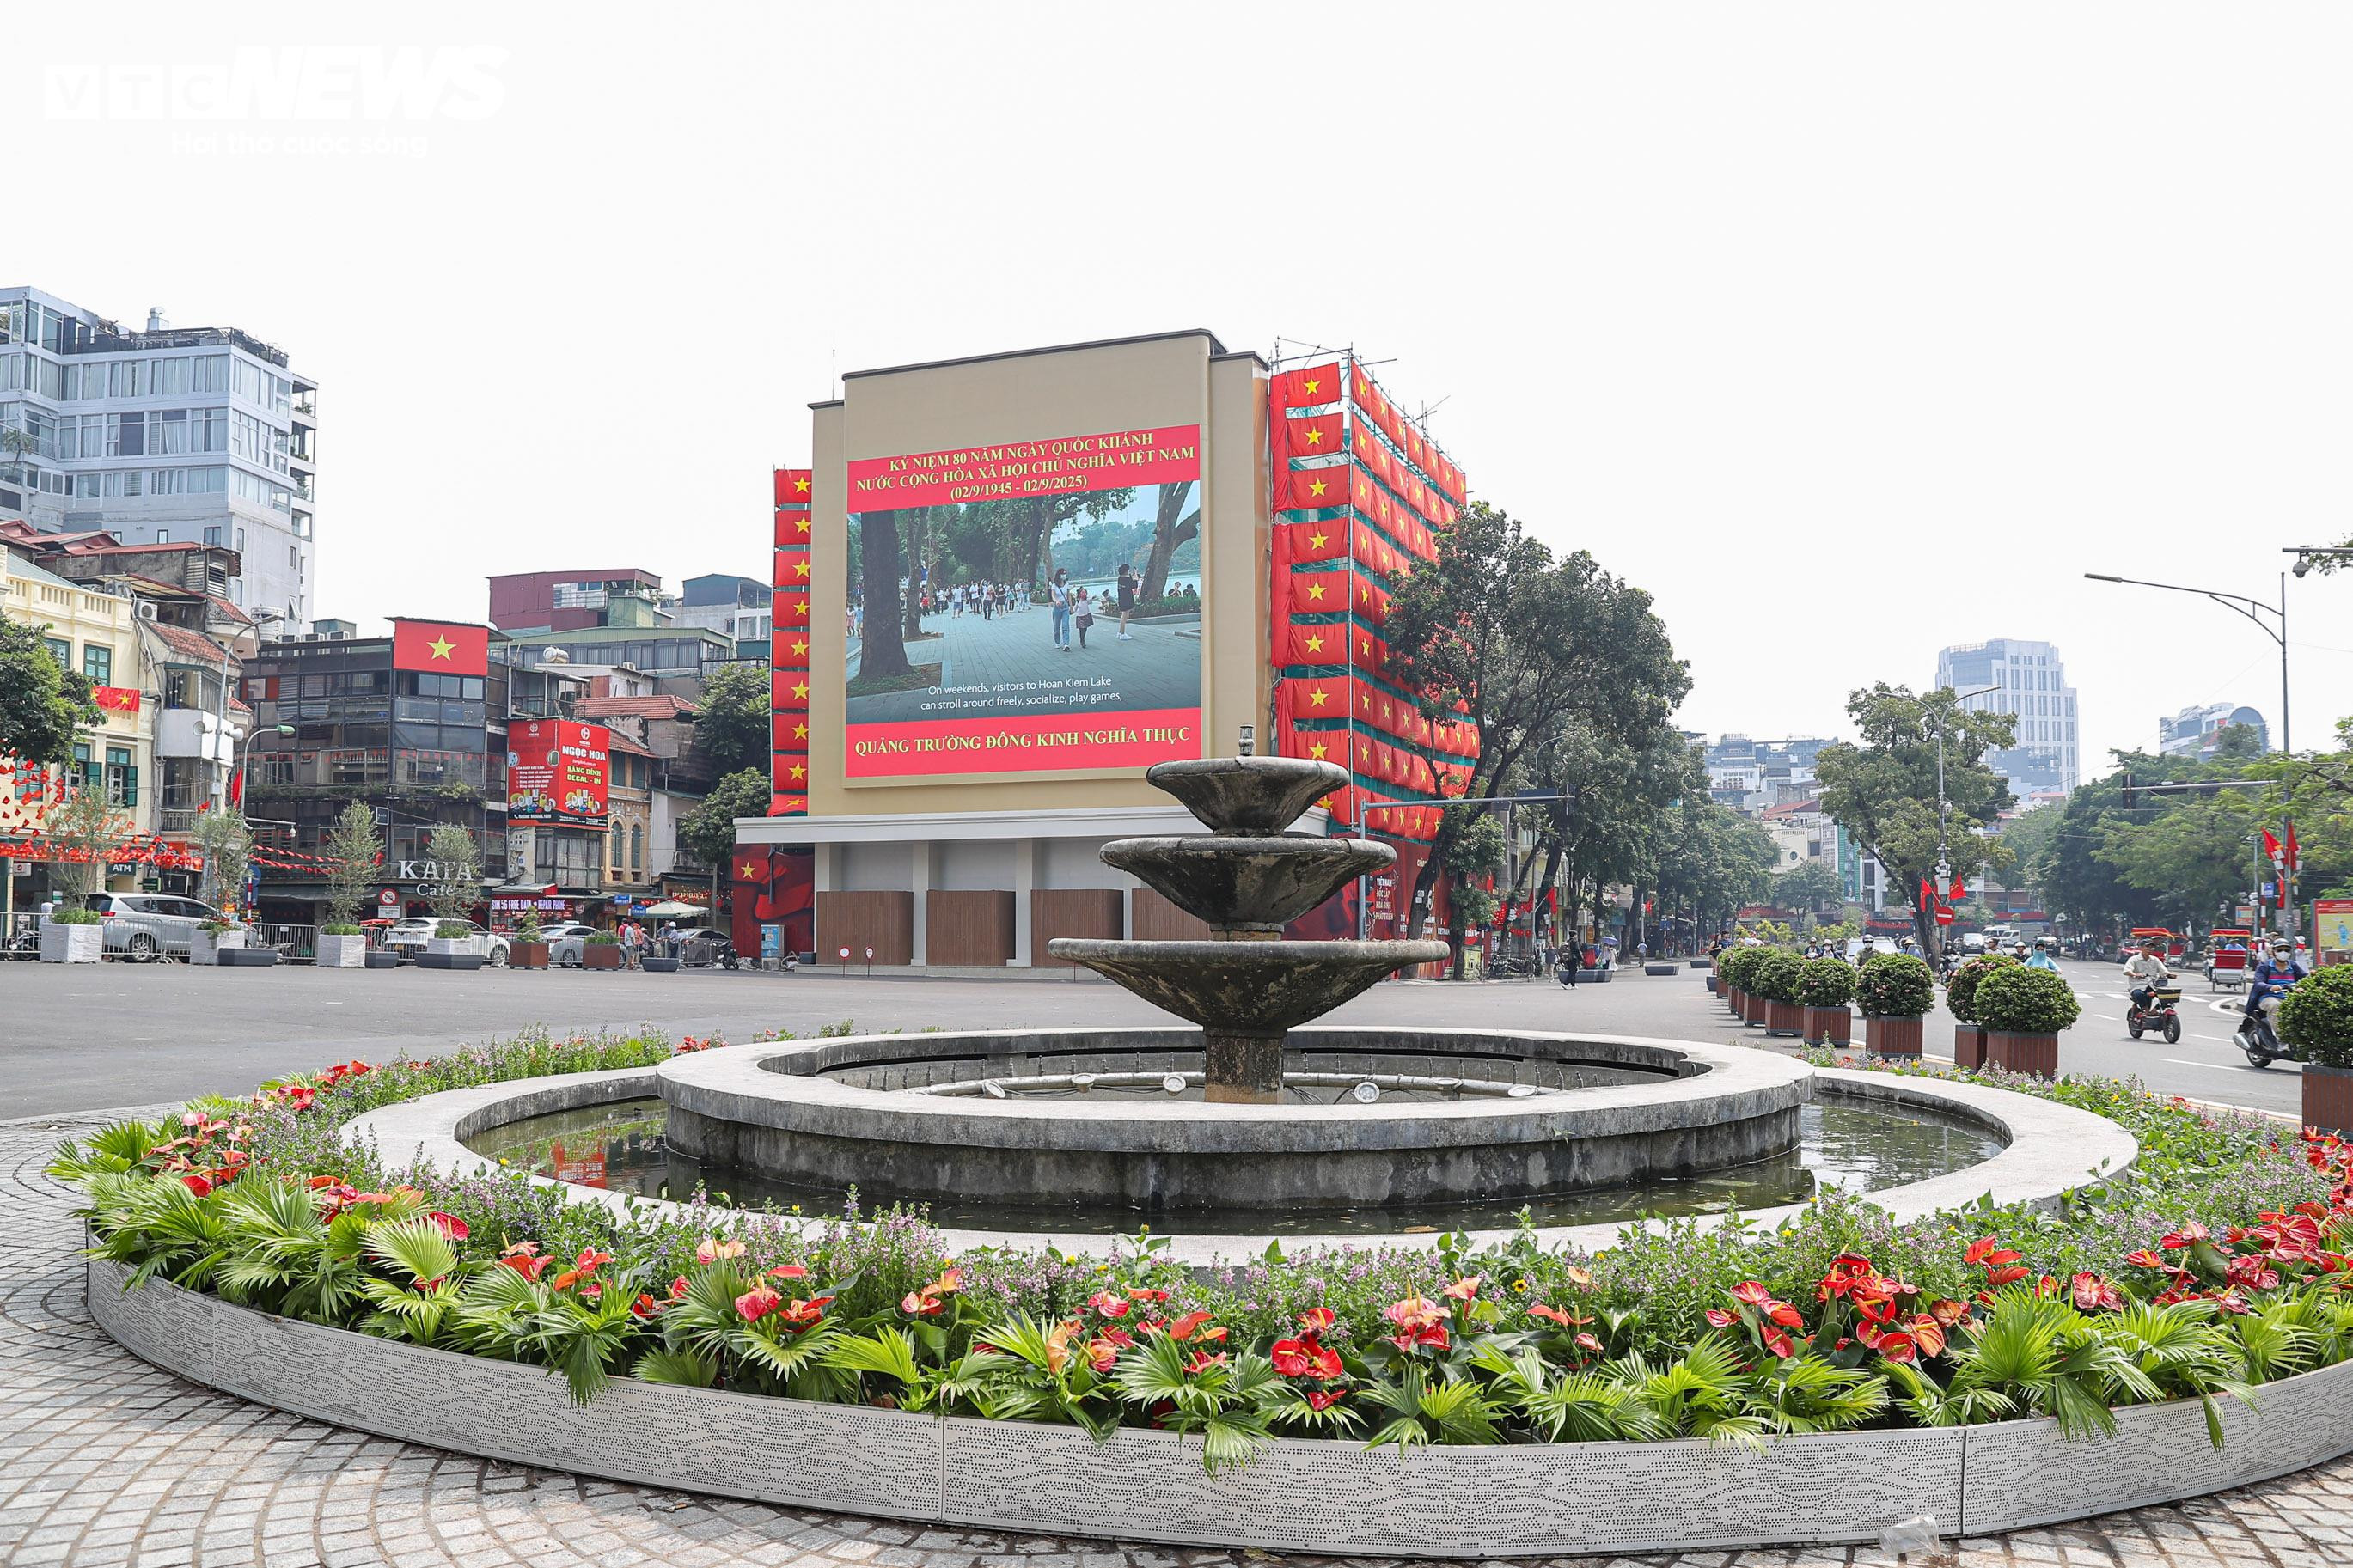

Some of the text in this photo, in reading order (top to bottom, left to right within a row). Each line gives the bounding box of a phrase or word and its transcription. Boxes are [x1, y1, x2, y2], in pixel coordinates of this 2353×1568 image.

[913, 455, 949, 470] NIỆM
[953, 453, 967, 465] 80
[970, 447, 1003, 463] NĂM
[1006, 442, 1048, 459] NGÀY
[1051, 436, 1095, 455] QUỐC
[1098, 432, 1153, 450] KHÁNH
[855, 446, 1195, 491] NƯỚC CỘNG HÒA XÃ HỘI CHỦ NGHĨA VIỆT NAM
[950, 482, 1012, 502] (02/9/1945
[1024, 474, 1088, 492] 02/9/2025)
[928, 676, 1112, 695] On weekends, visitors to Hoan Kiem Lake
[920, 692, 1122, 711] can stroll around freely, socialize, play games,
[855, 727, 1191, 756] QUẢNG TRƯỜNG ĐÔNG KINH NGHĨA THỤC
[562, 746, 606, 761] NGỌC HOA
[567, 774, 588, 783] DECAL
[112, 863, 131, 872] ATM
[416, 883, 454, 896] Café
[492, 900, 501, 910] SIM
[509, 900, 519, 910] FREE
[538, 900, 552, 910] REPAIR
[553, 900, 565, 910] PHONE
